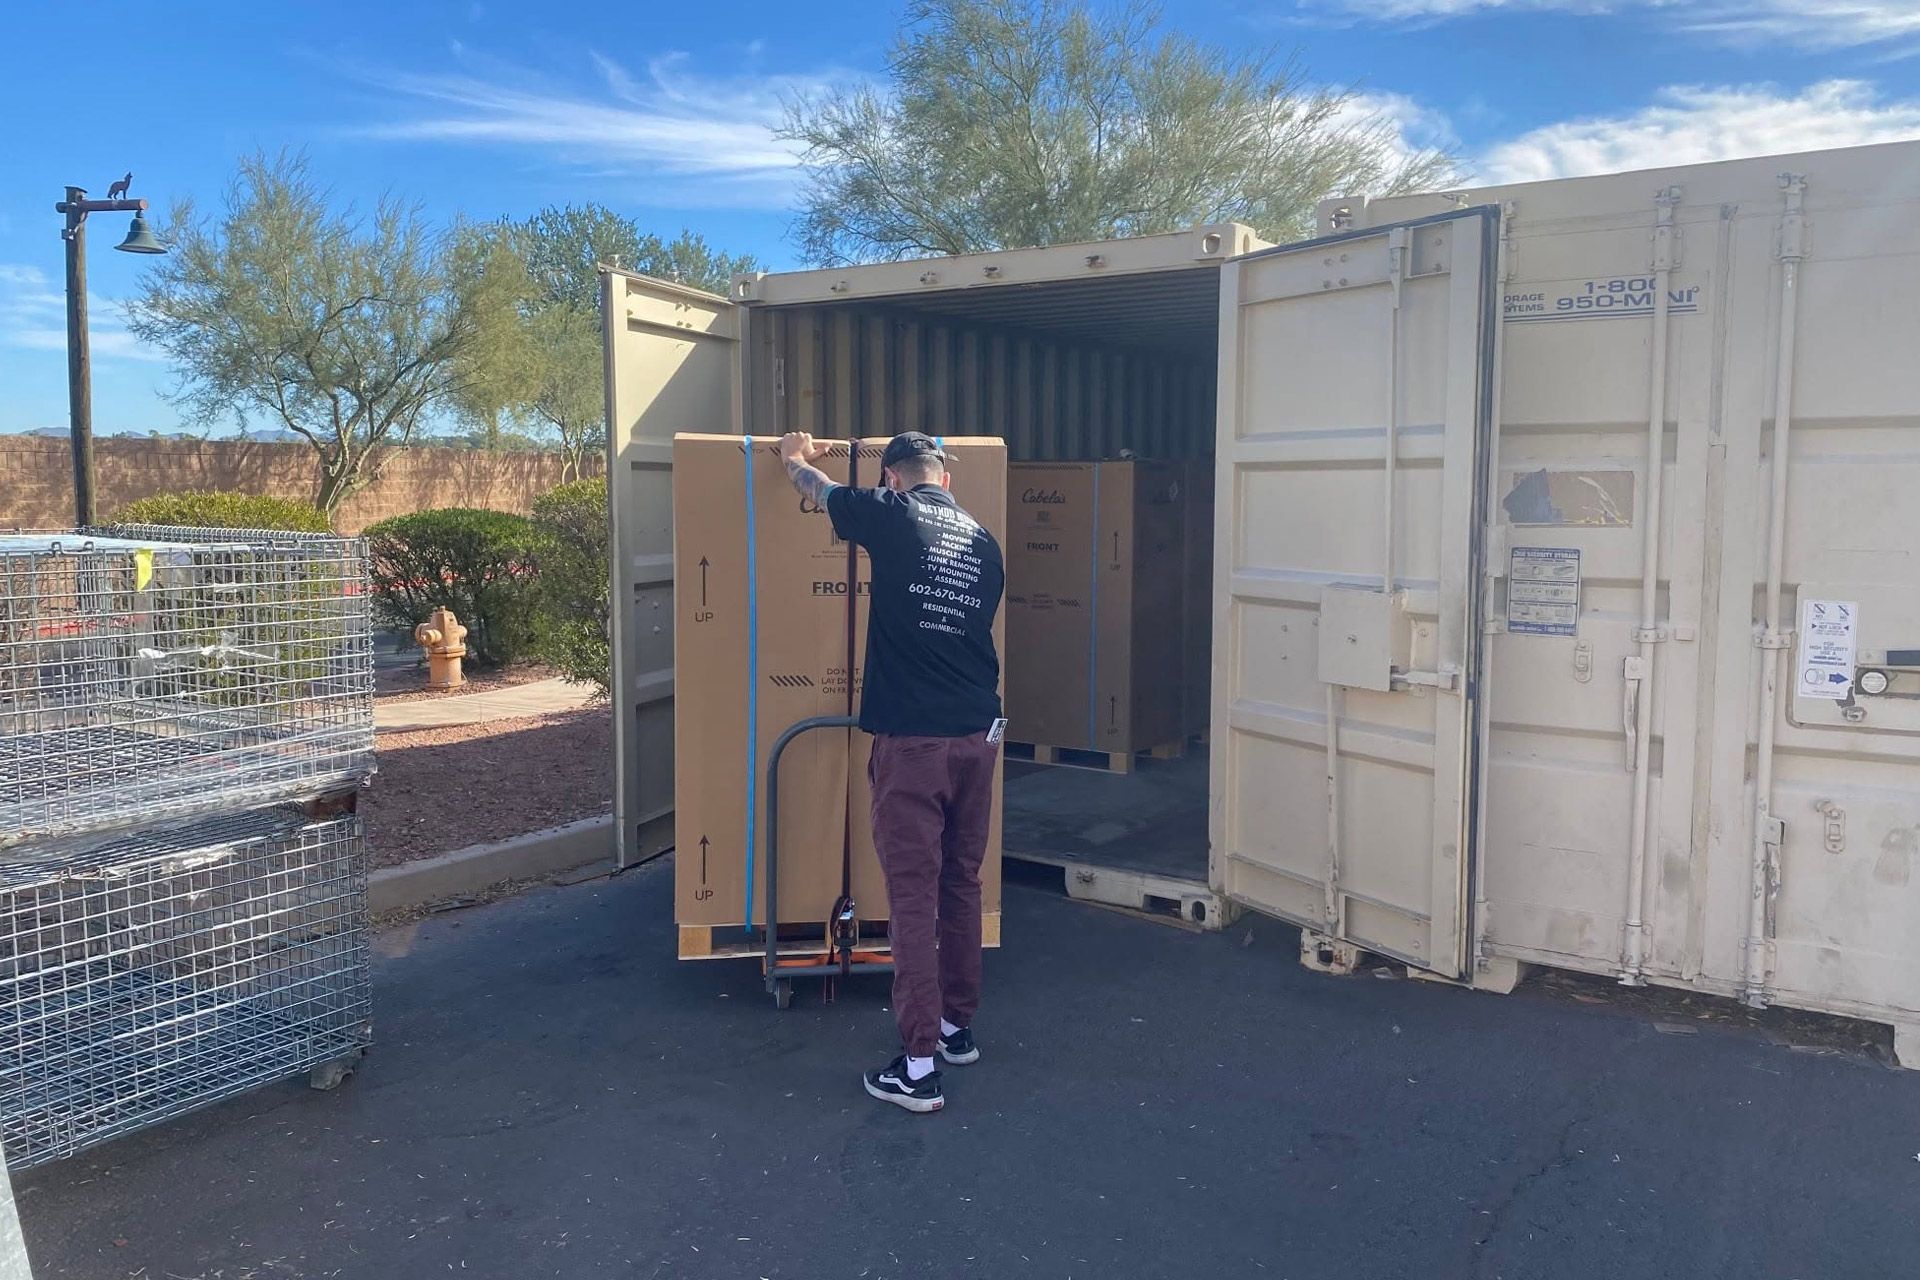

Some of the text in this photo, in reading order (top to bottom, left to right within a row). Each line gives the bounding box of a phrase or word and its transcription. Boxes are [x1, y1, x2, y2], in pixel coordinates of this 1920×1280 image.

[1504, 293, 1545, 303] ORAGE
[1503, 304, 1545, 313] STEMS
[942, 532, 973, 546] MOVING
[941, 540, 973, 554] PACKING
[1026, 542, 1060, 551] FRONT
[928, 546, 962, 559] MUSCLES
[963, 554, 982, 565] ONLY
[926, 555, 948, 565] JUNK
[949, 559, 982, 575] REMOVAL
[927, 564, 938, 572] TV
[939, 566, 979, 583] MOUNTING
[934, 575, 971, 589] ASSEMBLY
[908, 583, 982, 609] 602-670-4232
[694, 612, 714, 623] UP
[922, 602, 966, 619] RESIDENTIAL
[919, 621, 966, 636] COMMERCIAL
[695, 890, 714, 901] UP
